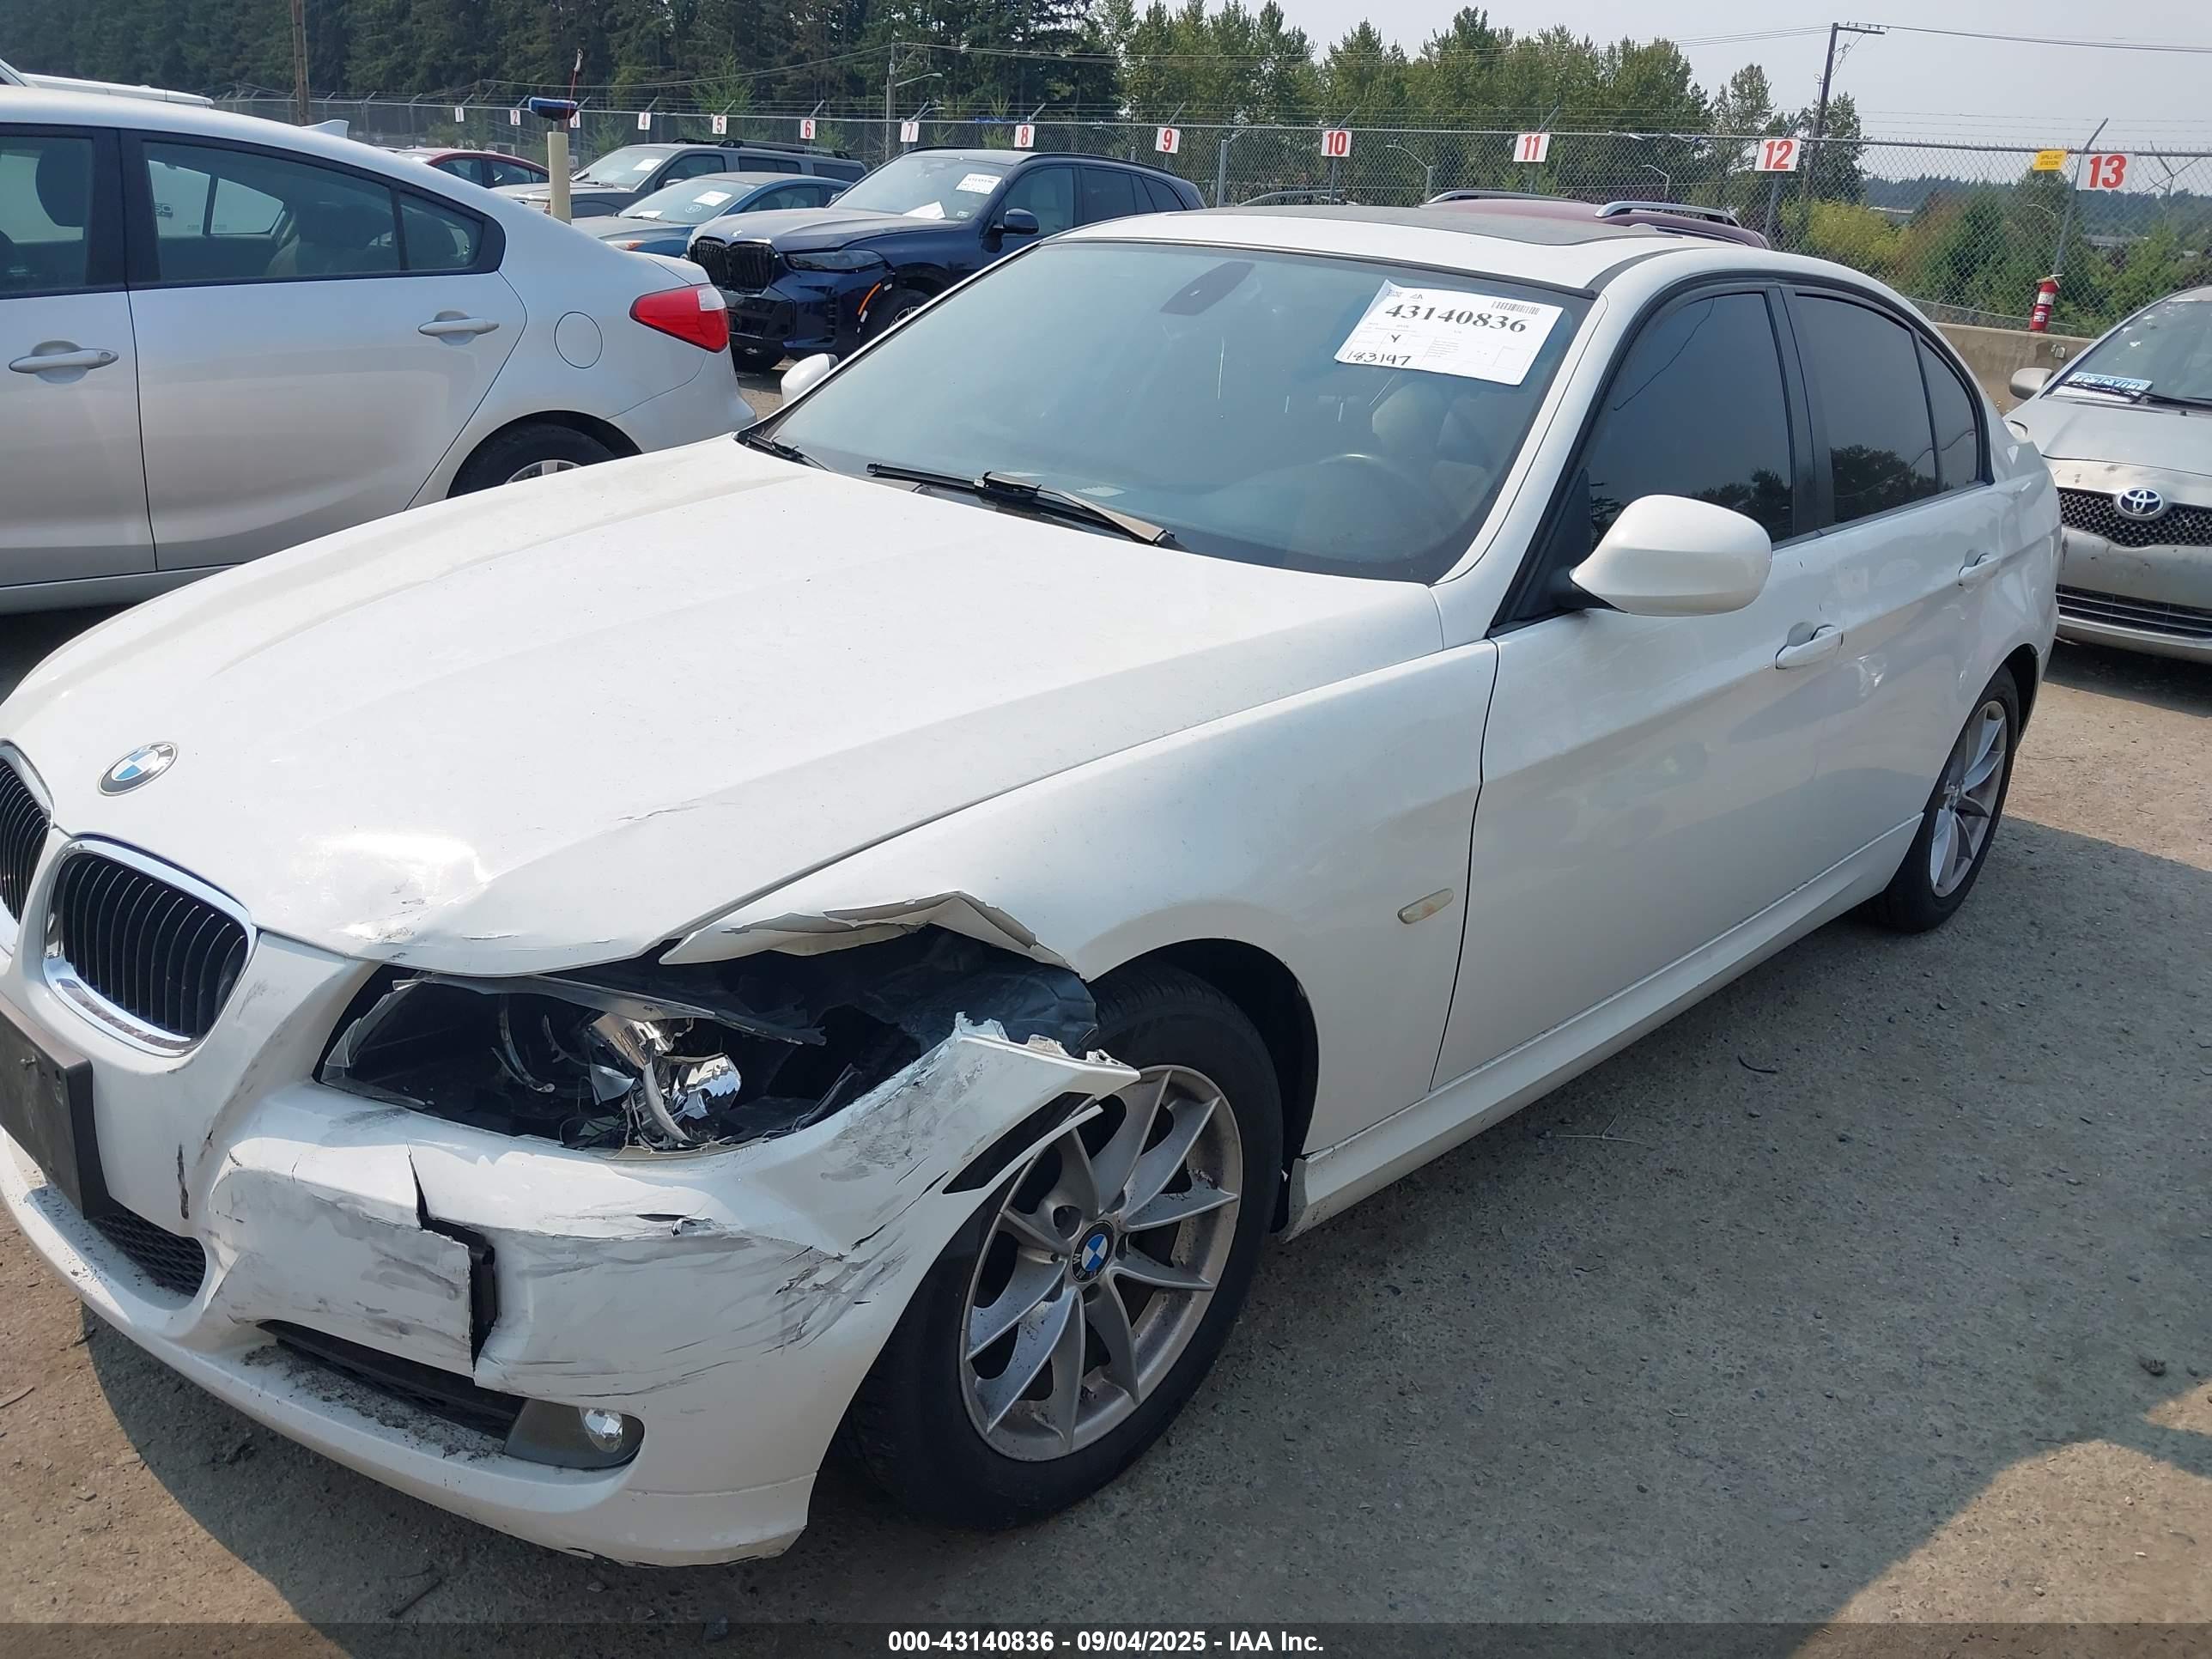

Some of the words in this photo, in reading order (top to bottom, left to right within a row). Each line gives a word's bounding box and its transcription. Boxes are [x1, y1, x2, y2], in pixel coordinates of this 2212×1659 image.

[716, 117, 722, 132] 5
[805, 121, 811, 138] 6
[907, 123, 914, 141] 7
[1021, 126, 1029, 146] 8
[1163, 130, 1173, 151] 9
[1327, 131, 1346, 155] 10
[1523, 135, 1541, 160] 11
[1764, 140, 1793, 169] 12
[2089, 155, 2127, 189] 13
[1385, 303, 1532, 333] 43140836
